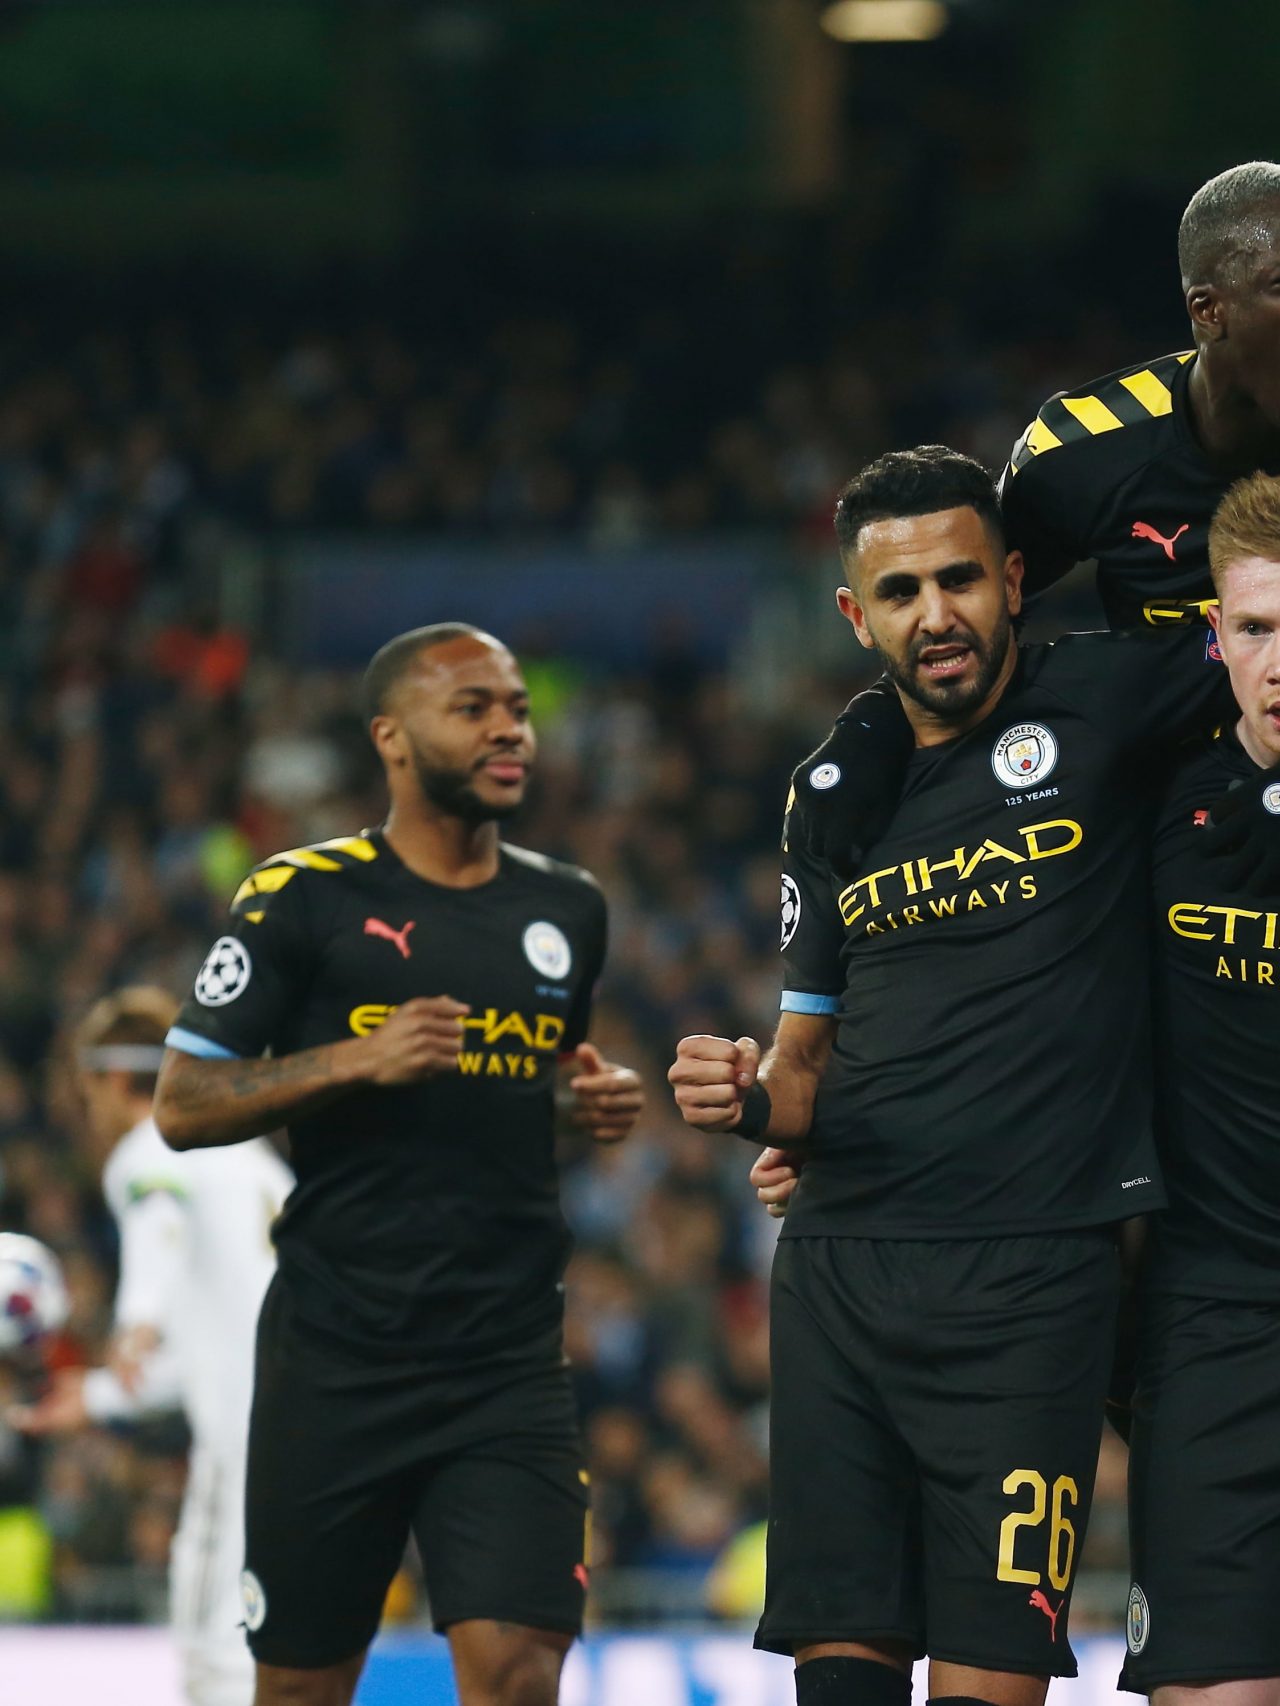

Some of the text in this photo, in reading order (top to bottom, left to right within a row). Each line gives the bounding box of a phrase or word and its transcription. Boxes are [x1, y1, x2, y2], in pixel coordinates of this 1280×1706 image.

[997, 726, 1047, 756] MANCHESTER
[1020, 773, 1039, 785] CITY
[1005, 787, 1059, 806] 125 YEARS
[838, 819, 1083, 926] ETIHAD
[866, 875, 1037, 936] AIRWAYS
[349, 1004, 565, 1048] EHAD
[456, 1051, 538, 1078] WAYS
[1121, 1176, 1151, 1189] DRYCELL
[997, 1468, 1078, 1592] 26
